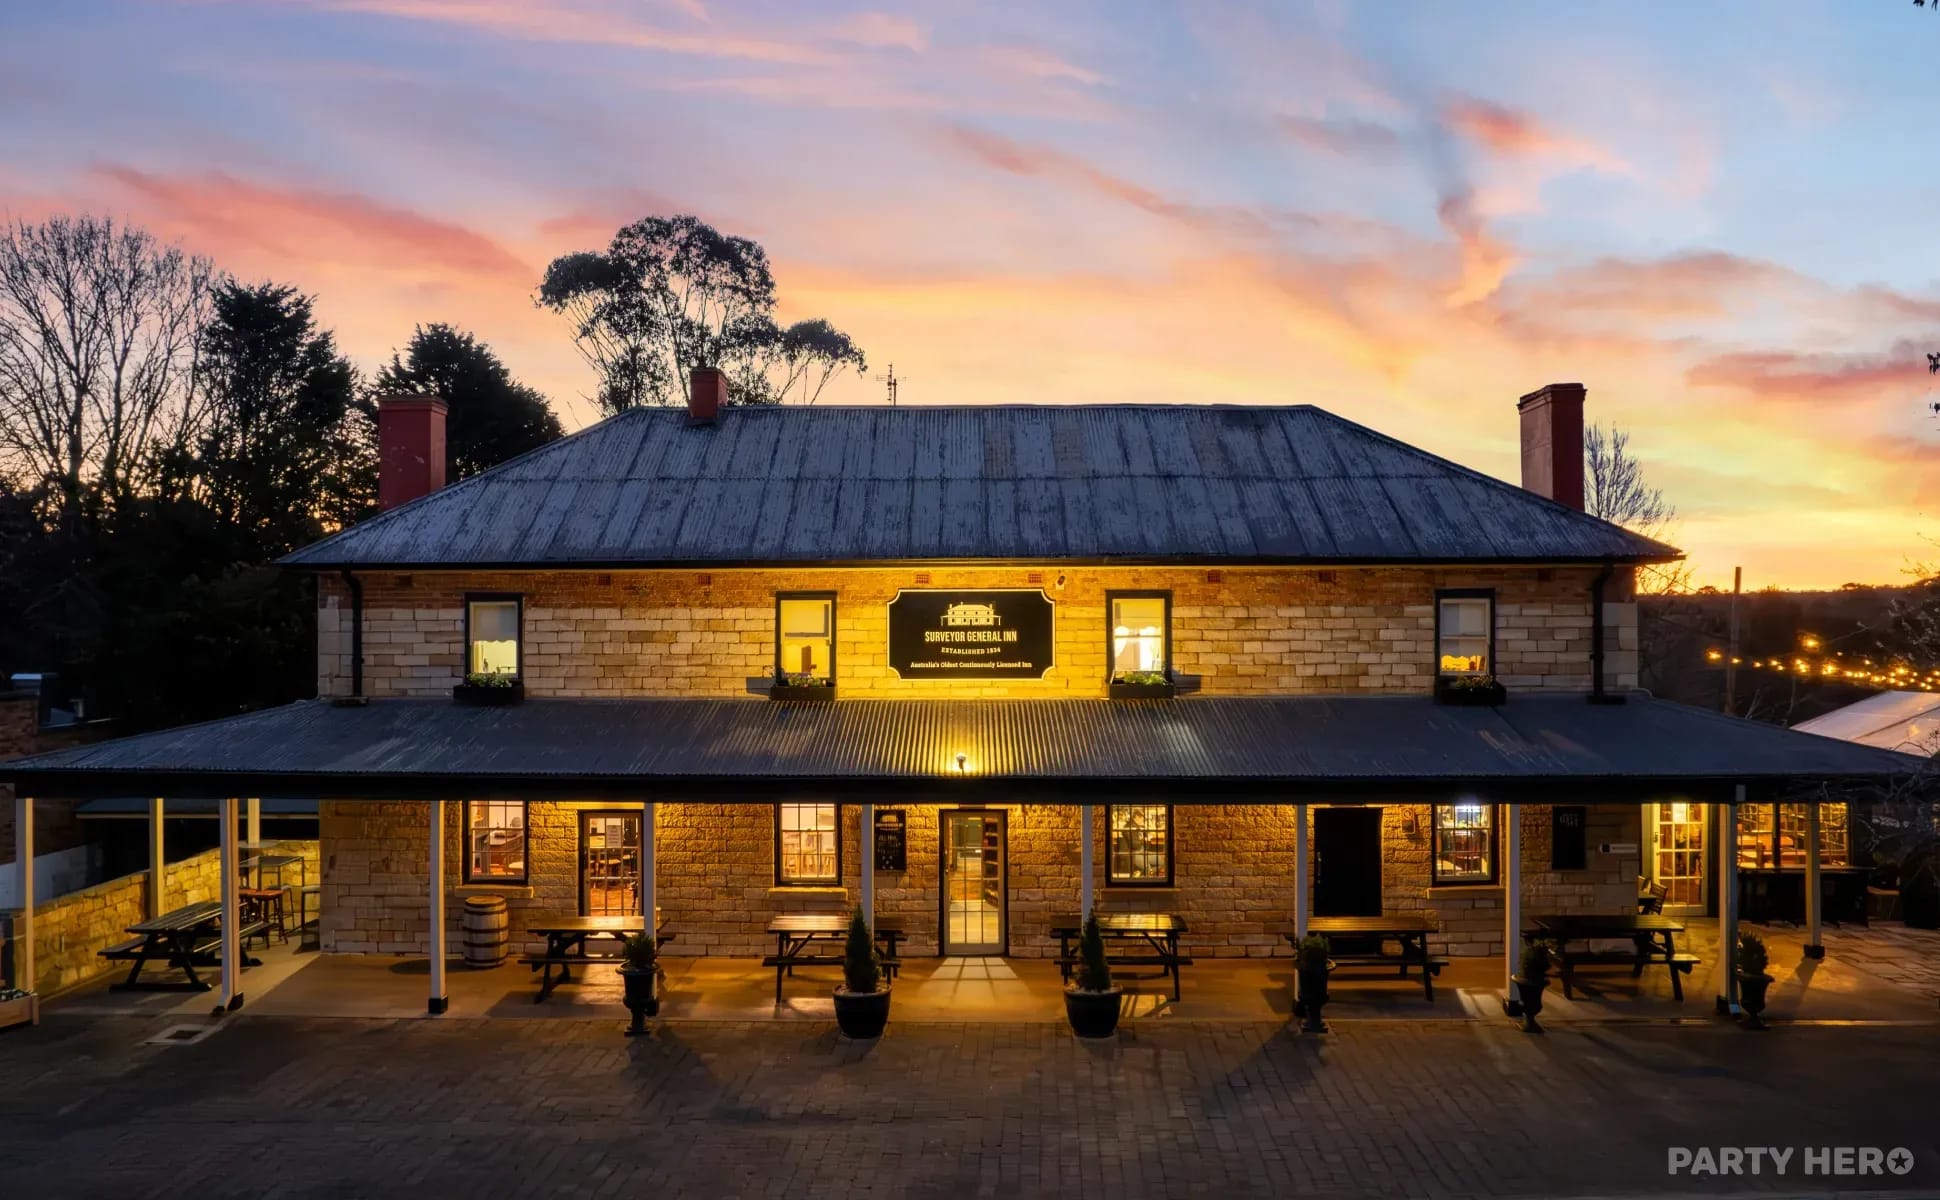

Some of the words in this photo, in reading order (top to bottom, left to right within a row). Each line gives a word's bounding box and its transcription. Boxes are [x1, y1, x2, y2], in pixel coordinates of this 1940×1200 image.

[925, 631, 966, 642] SURVEYOR
[967, 631, 1002, 642] GENERAL
[1003, 631, 1017, 642] INN
[941, 647, 985, 655] ESTABLISHED
[959, 661, 996, 669] Continuously
